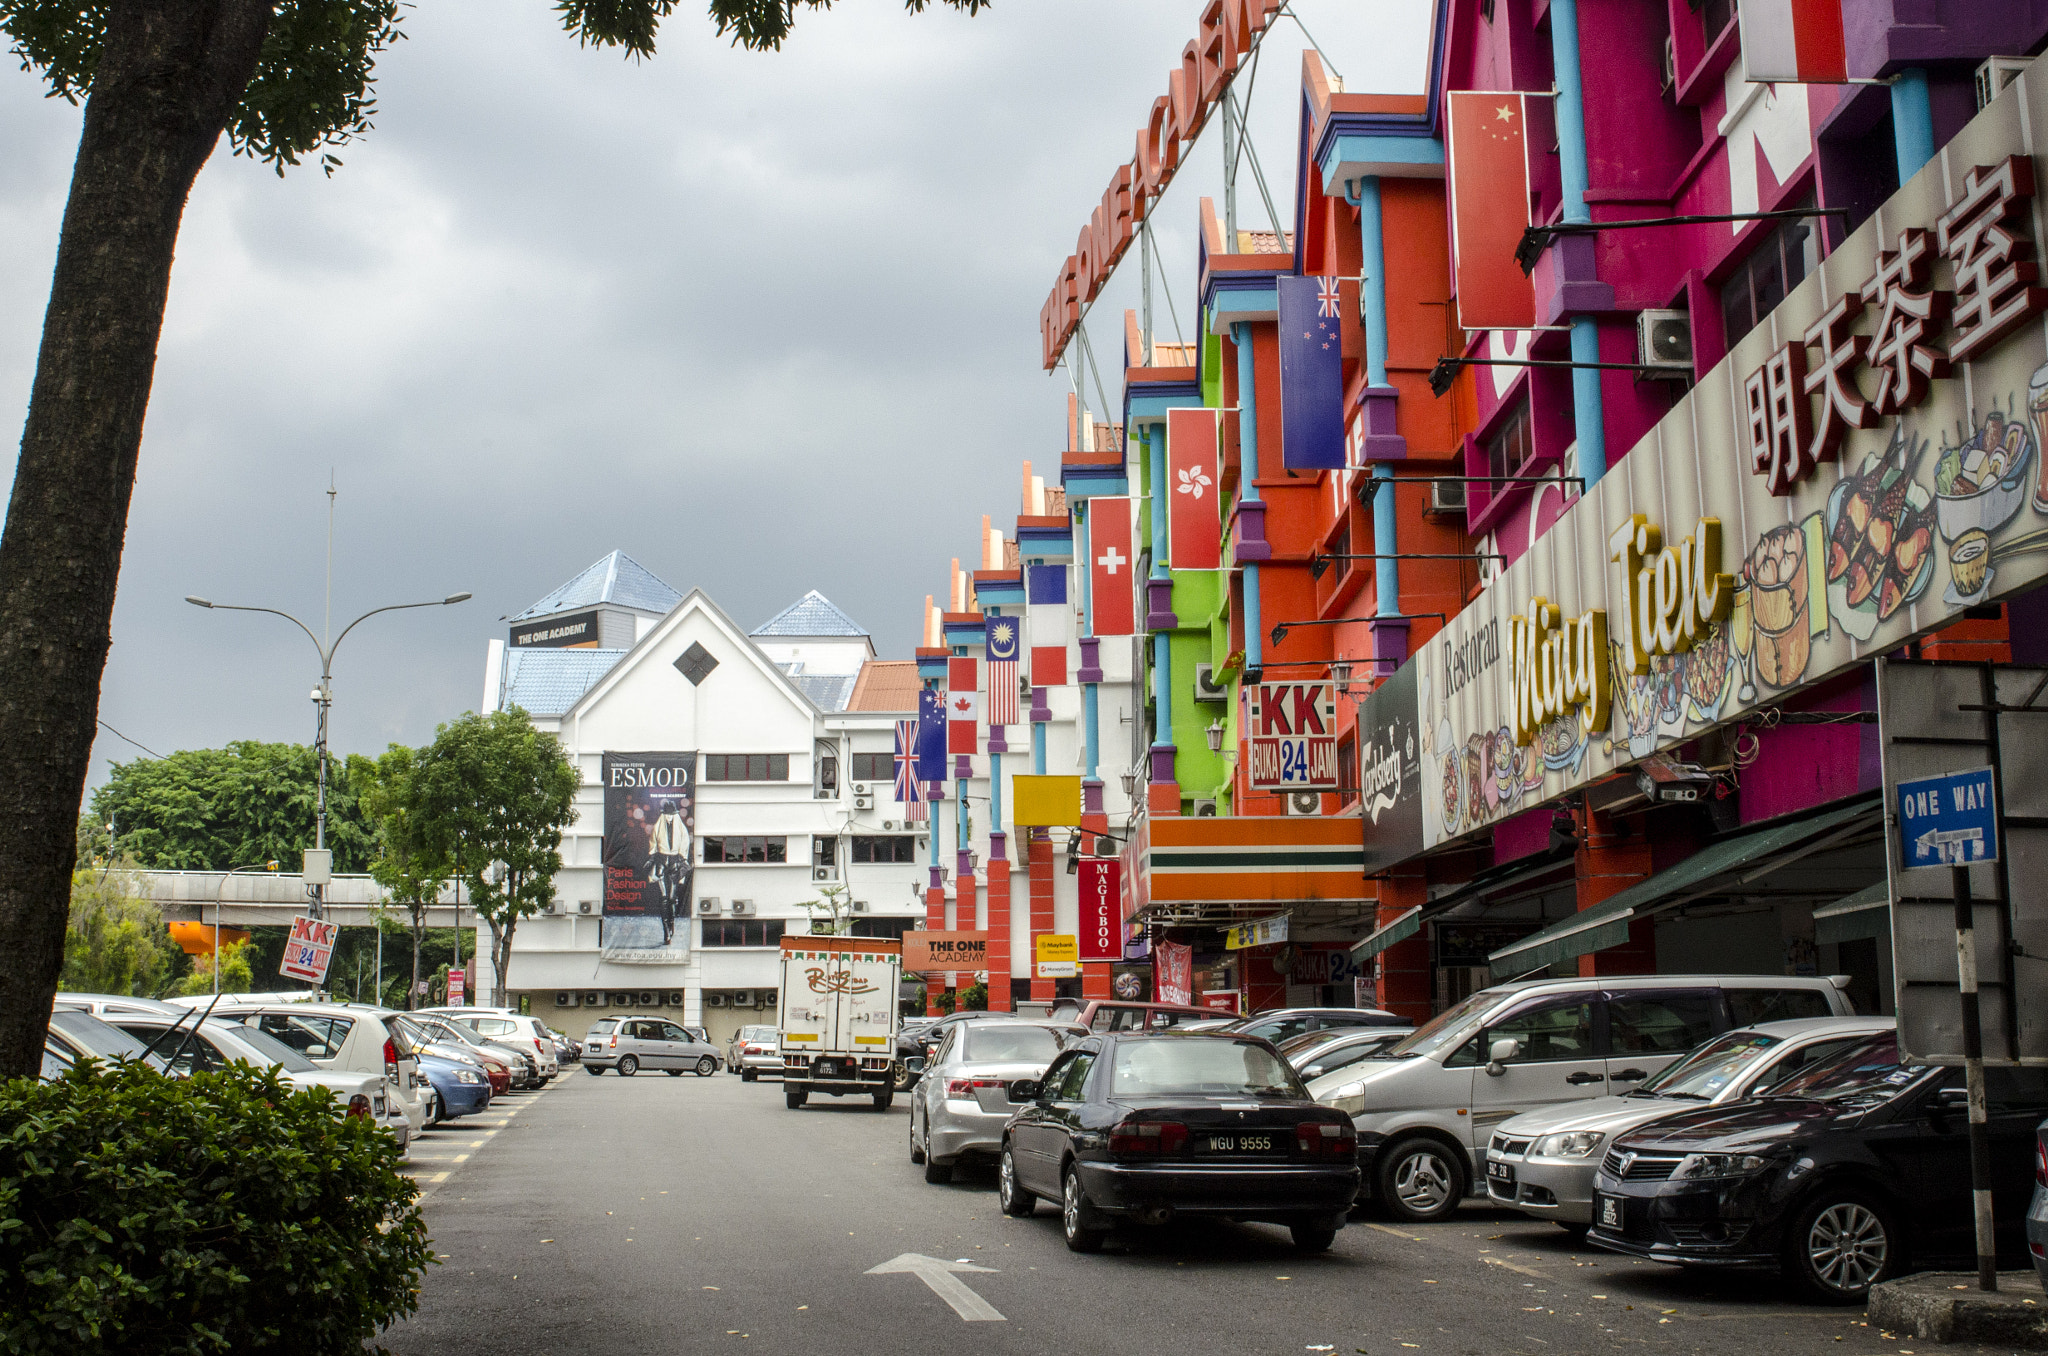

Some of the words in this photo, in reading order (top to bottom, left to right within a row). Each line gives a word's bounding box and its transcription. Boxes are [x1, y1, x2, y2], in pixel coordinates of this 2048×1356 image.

[1040, 255, 1079, 370] THE
[1076, 164, 1133, 304] ONE
[1744, 155, 2048, 497] 明天茶室
[518, 633, 533, 645] THE
[532, 630, 549, 642] ONE
[549, 622, 587, 639] ACADEMY
[1443, 615, 1500, 699] Restoran
[1507, 596, 1612, 746] Ming
[1608, 513, 1734, 676] Tien
[1260, 685, 1326, 735] KK
[1253, 743, 1279, 780] BUKA
[1282, 739, 1308, 781] 24
[1311, 742, 1336, 779] JAM
[610, 767, 688, 788] ESMOD
[1361, 740, 1401, 820] Carlsberg
[1904, 790, 1940, 820] ONE
[1953, 782, 1986, 812] WAY
[607, 878, 646, 889] Fashion
[608, 866, 633, 878] Paris
[607, 890, 642, 903] Design
[1096, 863, 1110, 948] MAGICBOO
[295, 918, 332, 945] KK
[299, 947, 314, 966] 24
[928, 951, 986, 963] ACADEMY
[929, 941, 954, 951] THE
[956, 940, 986, 951] ONE
[1047, 965, 1073, 973] MoneyGram
[1296, 955, 1327, 981] BUKA
[1210, 1136, 1234, 1150] WGU
[1240, 1136, 1271, 1150] 9555
